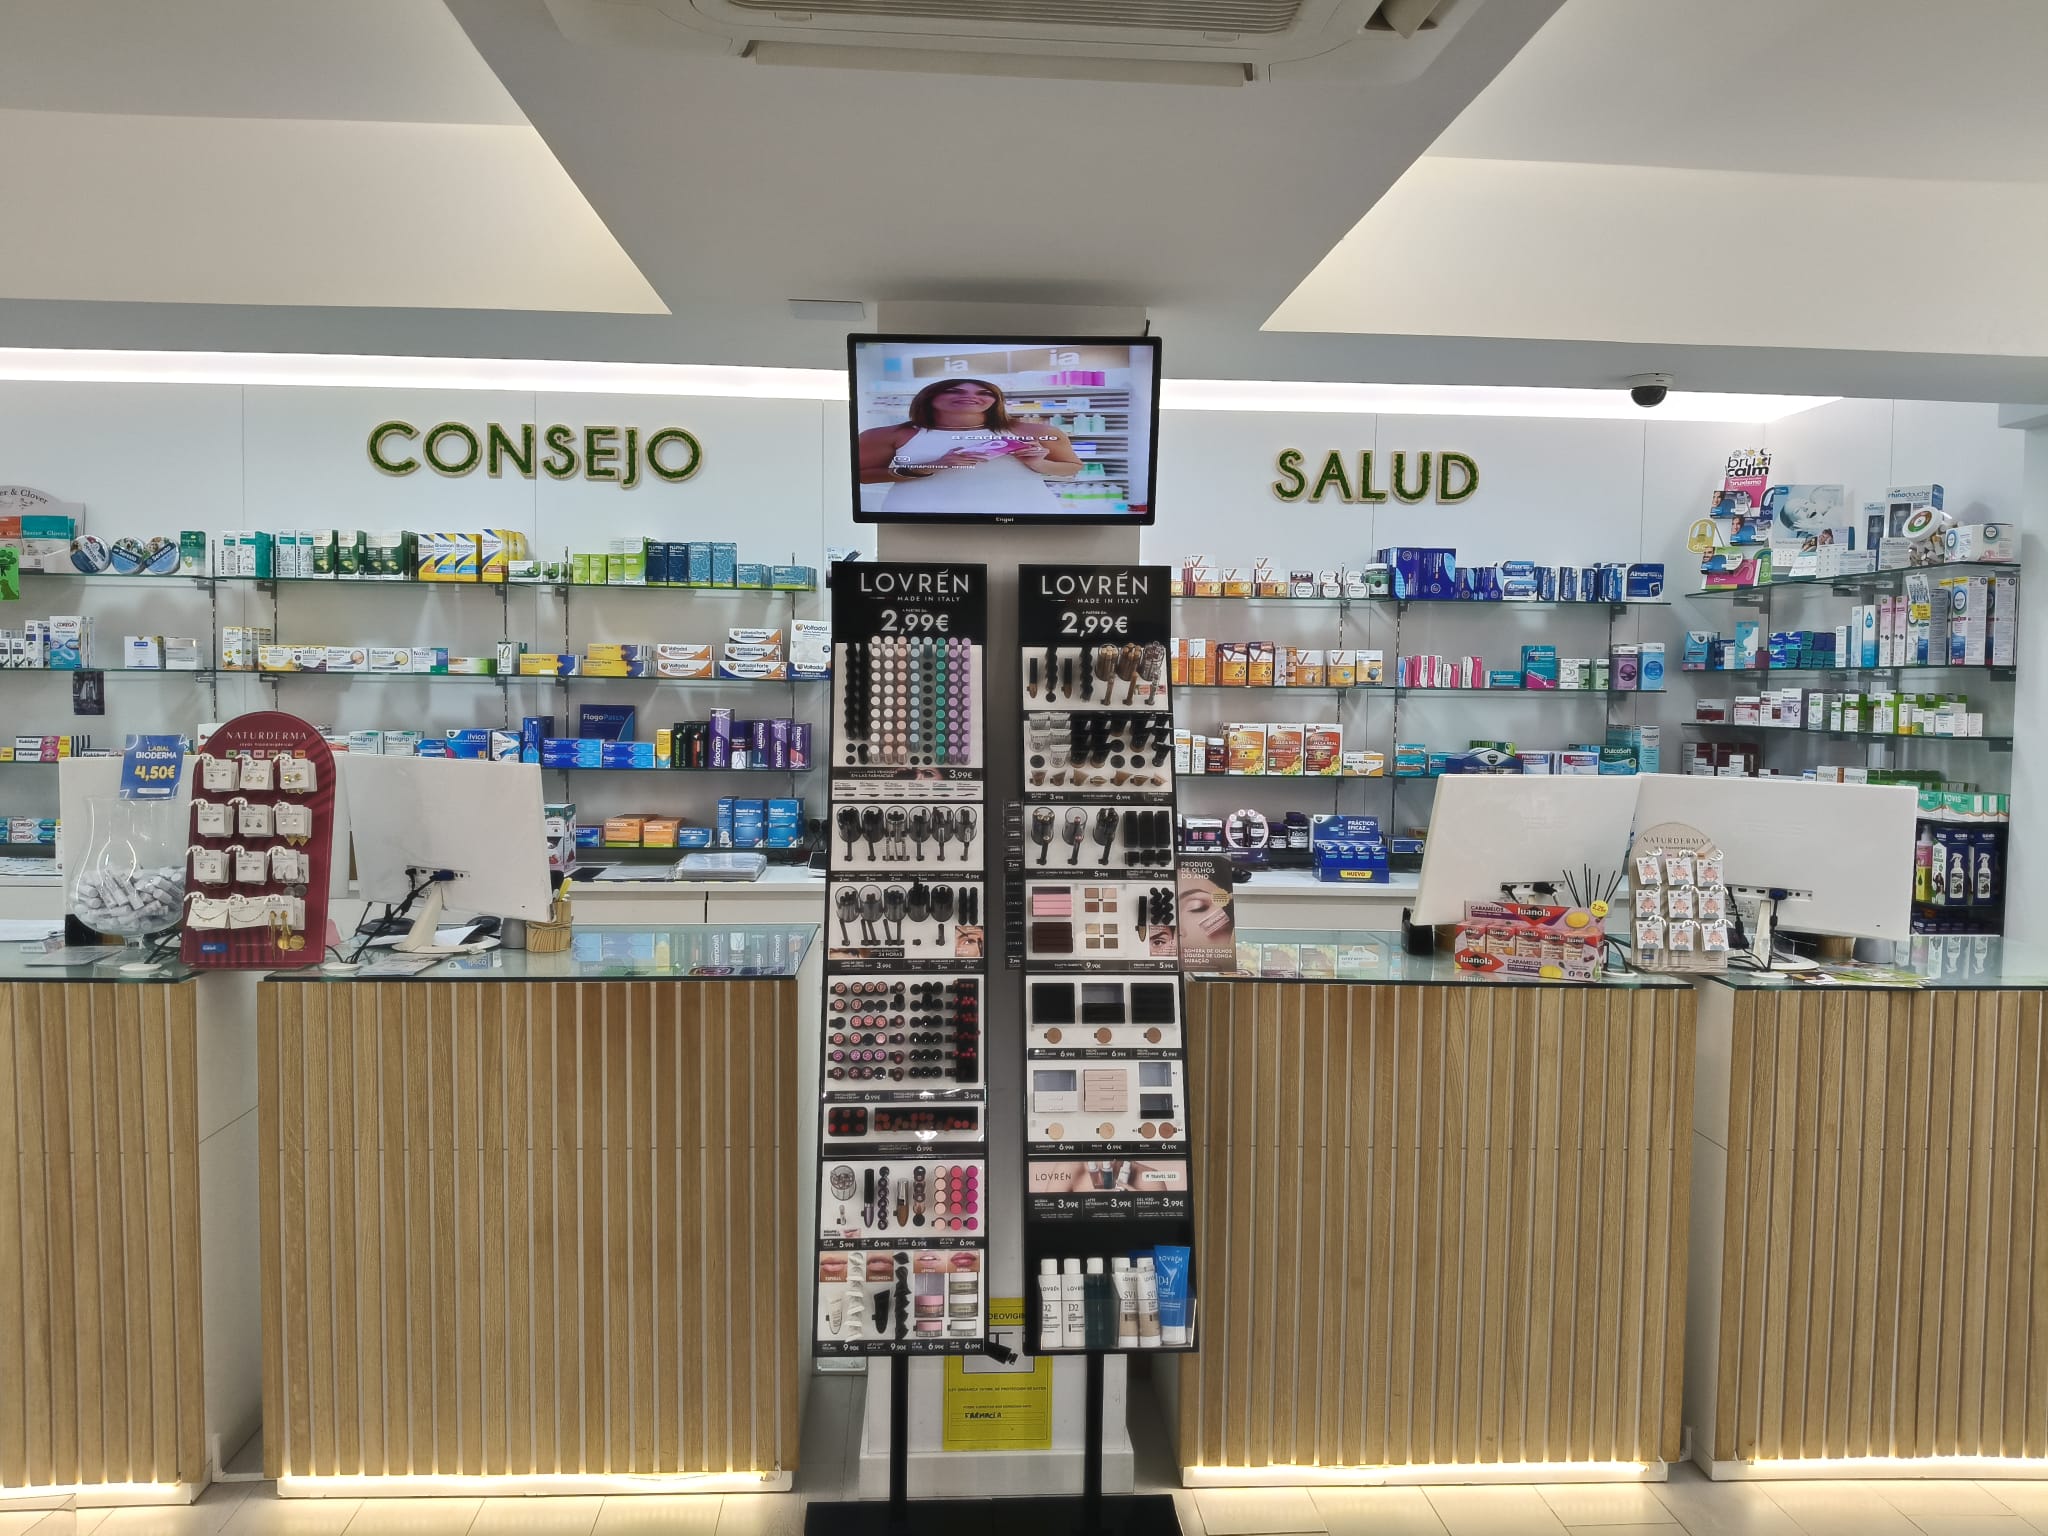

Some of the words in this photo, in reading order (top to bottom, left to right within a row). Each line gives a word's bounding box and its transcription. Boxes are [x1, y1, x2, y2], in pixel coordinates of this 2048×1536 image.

[367, 420, 703, 489] CONSEJO
[1272, 448, 1480, 505] SALUD
[1727, 466, 1769, 477] calm
[20, 489, 49, 505] Clover
[1887, 489, 1930, 500] rhinodouche
[861, 569, 969, 593] LOVRÉN
[1042, 571, 1148, 596] LOVRÉN
[803, 623, 828, 632] Voltadol
[881, 609, 949, 635] 2,99€
[1061, 612, 1128, 637] 2,99€
[226, 730, 309, 741] NATURDERMA
[467, 733, 487, 741] ilvico
[135, 751, 177, 760] BIODERMA
[1603, 747, 1632, 755] DulcoSoft
[134, 765, 176, 782] 4,50€
[949, 769, 974, 779] 3,99€
[1643, 836, 1707, 846] NATURDERMA
[1470, 905, 1504, 913] CARAMELOS
[1035, 1172, 1073, 1181] LOVRÉN
[1057, 1198, 1079, 1209] 3,99€
[1110, 1198, 1132, 1208] 3,99€
[1162, 1197, 1184, 1208] 3,99€
[1068, 1303, 1079, 1312] D2
